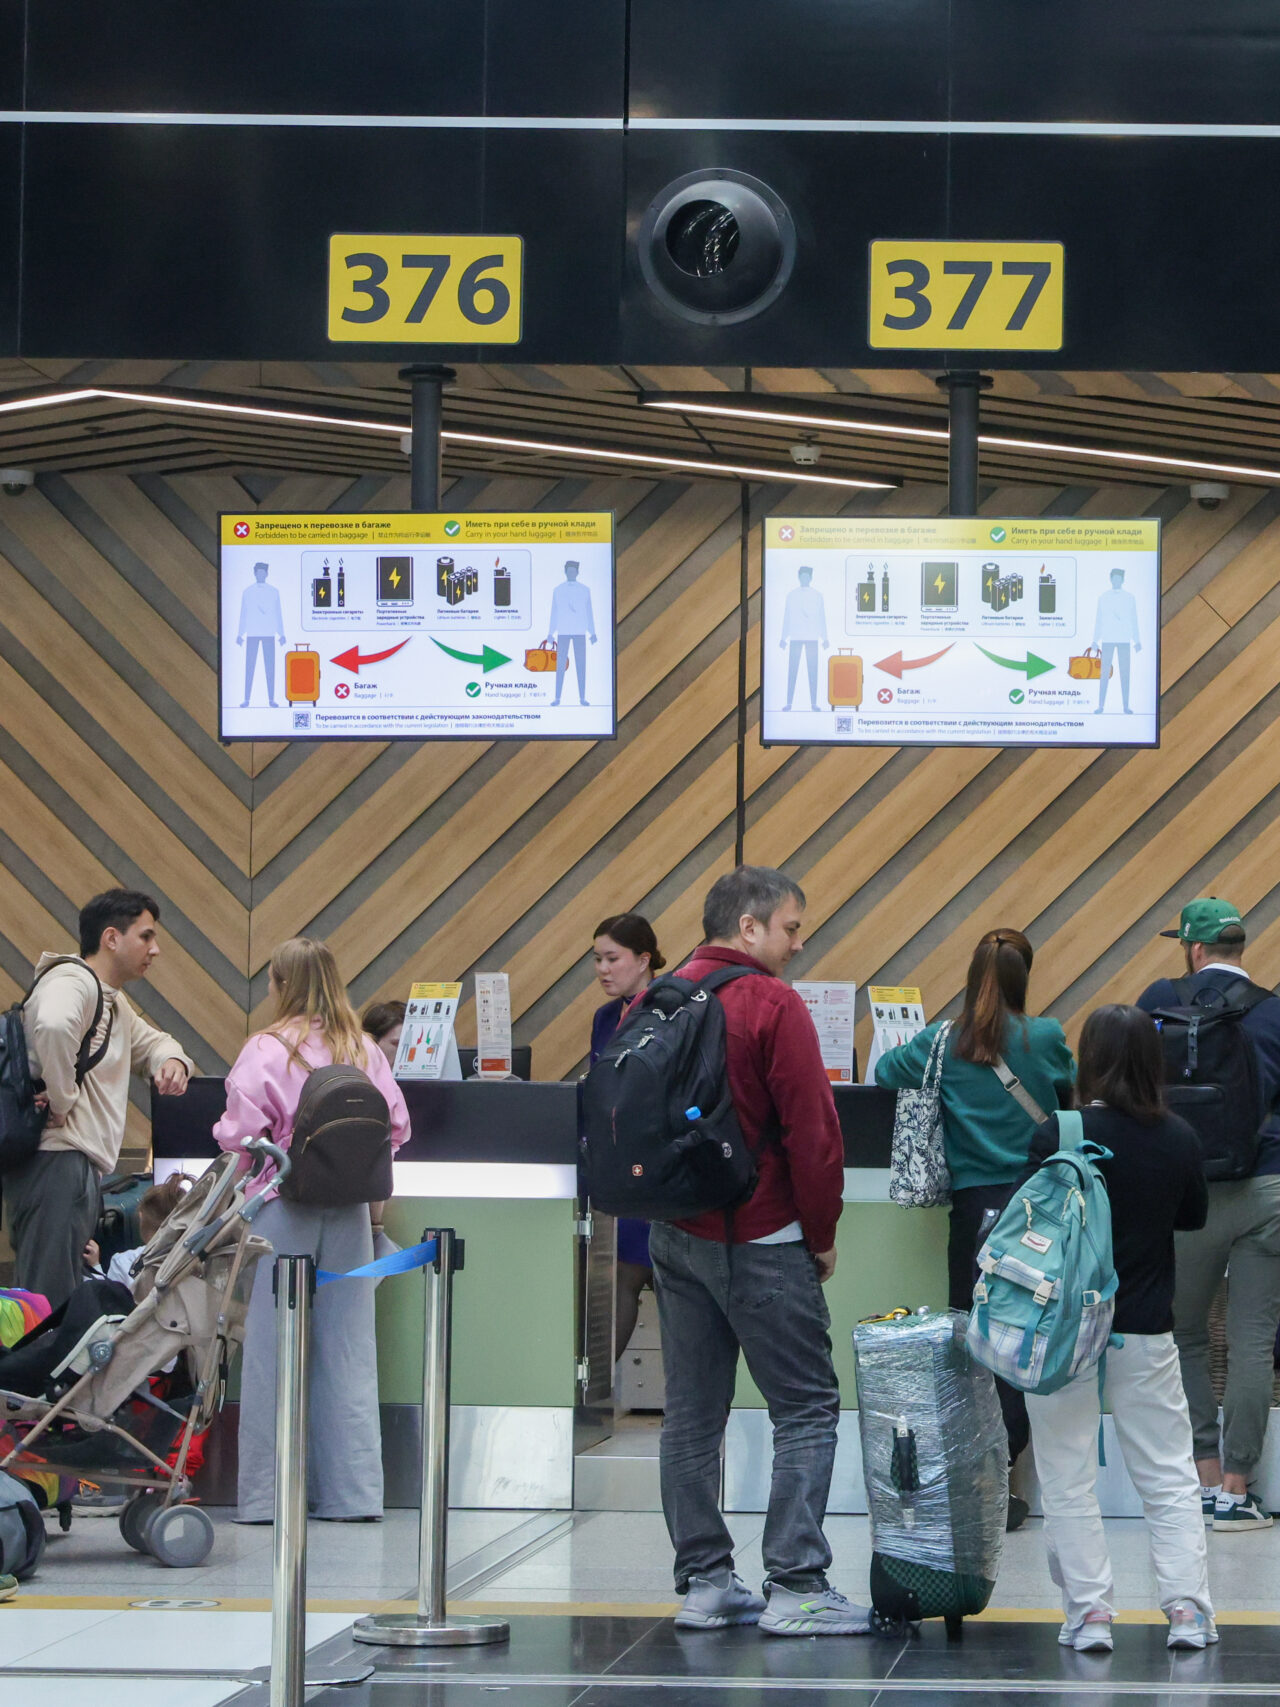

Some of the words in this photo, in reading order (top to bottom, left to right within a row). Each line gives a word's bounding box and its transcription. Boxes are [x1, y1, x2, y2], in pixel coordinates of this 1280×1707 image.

[340, 252, 512, 325] 376
[882, 259, 1052, 331] 377
[465, 531, 483, 539] Carry
[528, 531, 556, 539] luggage
